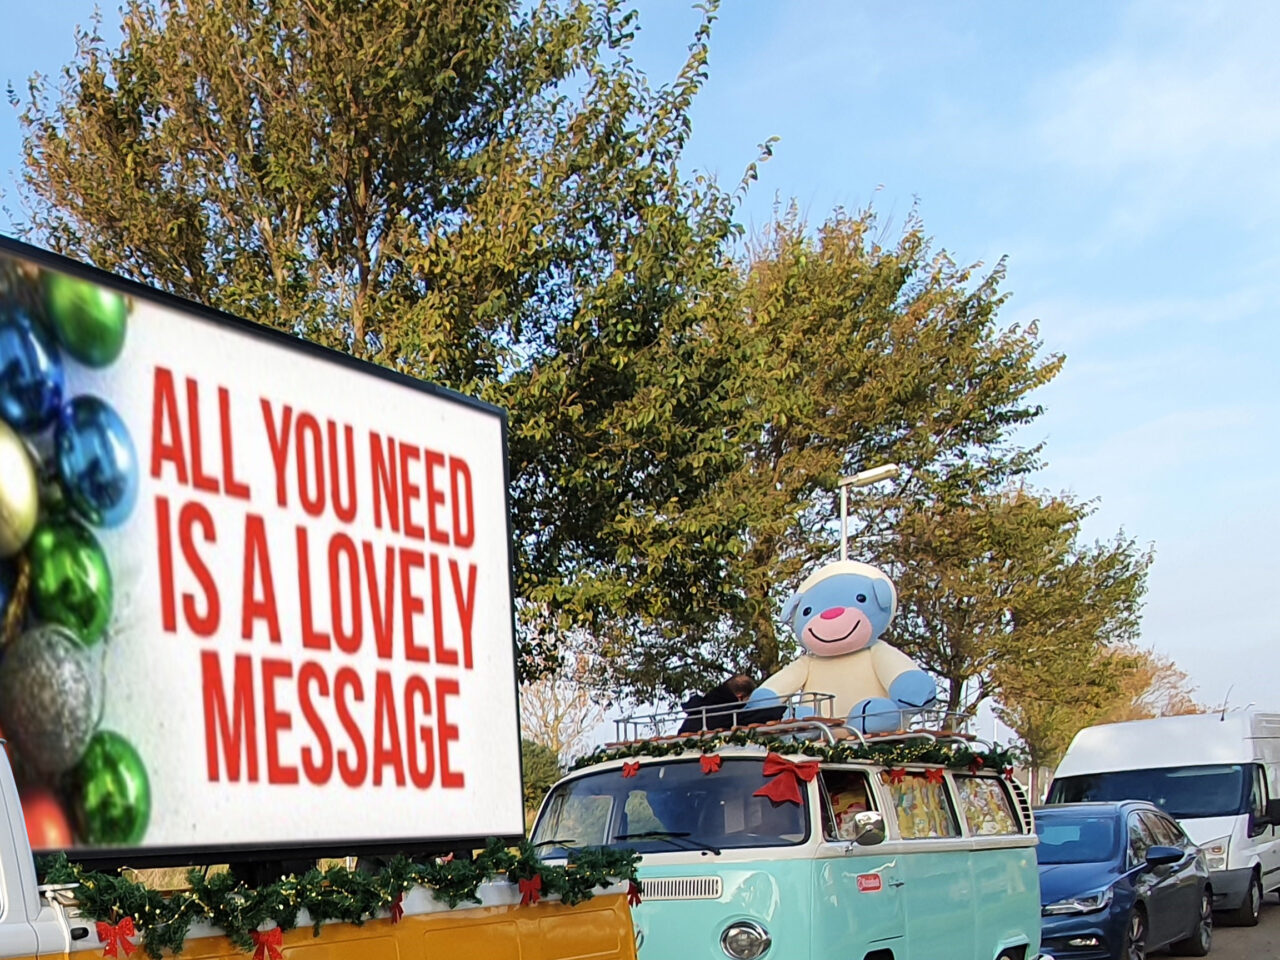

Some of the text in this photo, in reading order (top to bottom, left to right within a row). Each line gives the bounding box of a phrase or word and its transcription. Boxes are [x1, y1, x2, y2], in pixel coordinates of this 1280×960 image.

[150, 366, 475, 549] ALL YOU NEED
[154, 495, 478, 670] IS A LOVELY
[200, 649, 465, 789] MESSAGE
